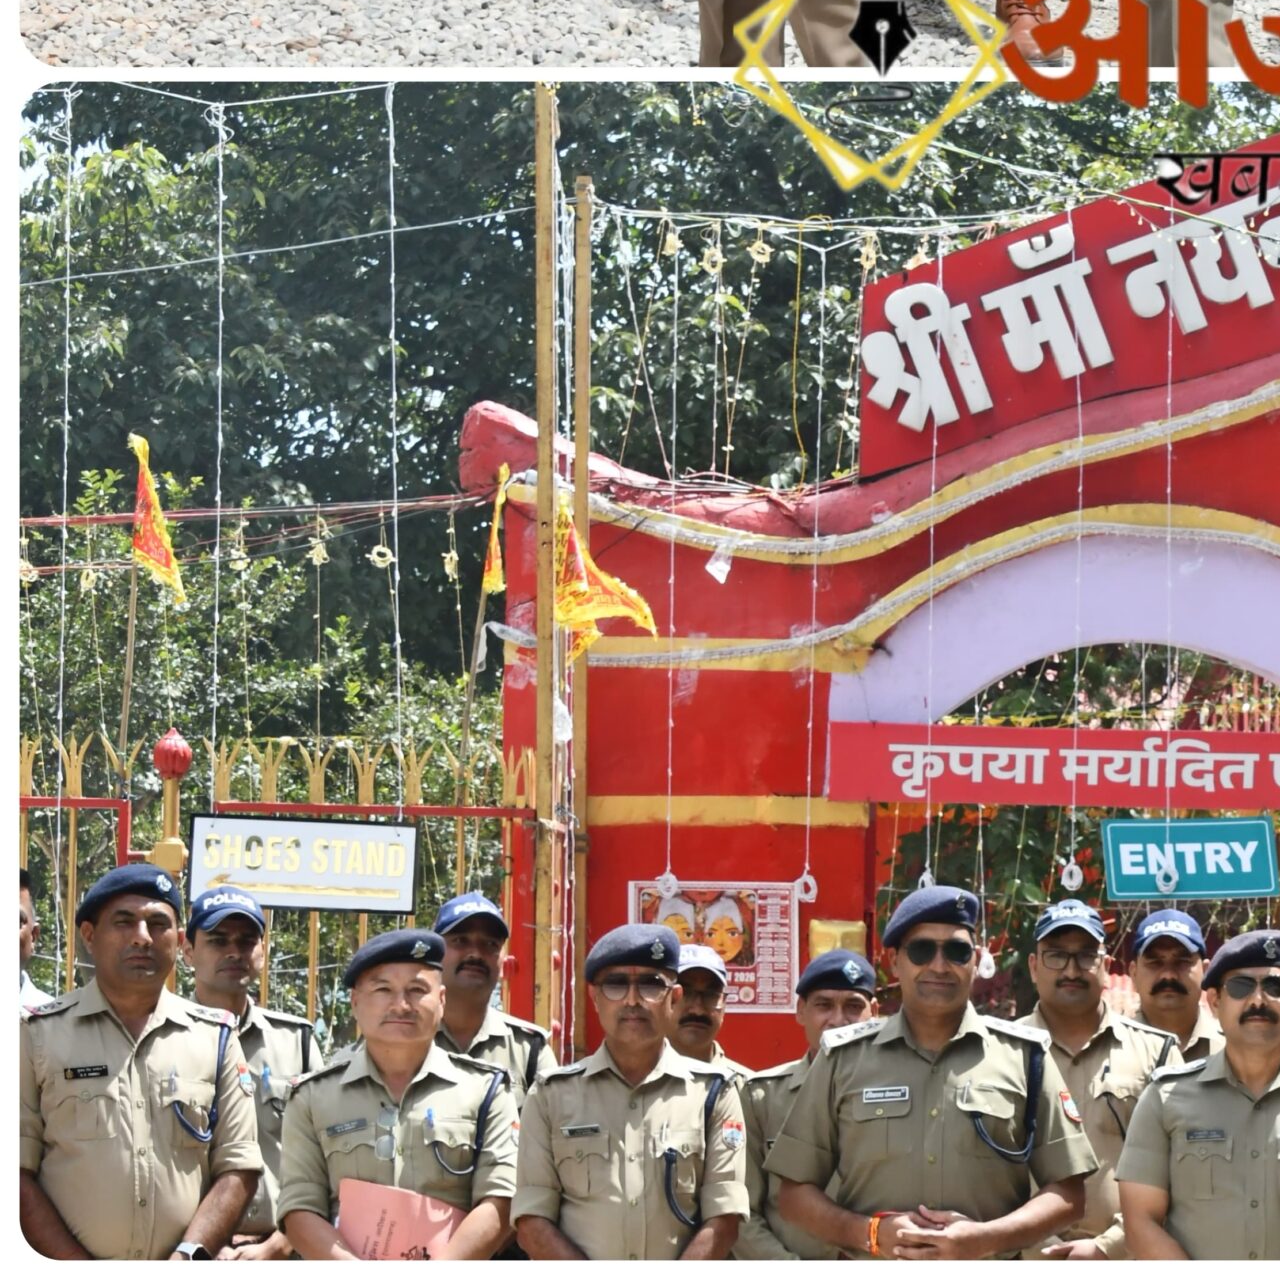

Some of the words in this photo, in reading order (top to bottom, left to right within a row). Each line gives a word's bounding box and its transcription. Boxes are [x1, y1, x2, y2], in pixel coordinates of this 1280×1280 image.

[861, 282, 993, 432] श्री
[888, 743, 1050, 798] कृपया
[1059, 737, 1260, 791] मर्यादित
[203, 833, 302, 873] SHOES
[311, 837, 406, 878] STAND
[1119, 841, 1259, 875] ENTRY
[203, 893, 257, 911] POLICE
[1143, 920, 1191, 937] POLICE
